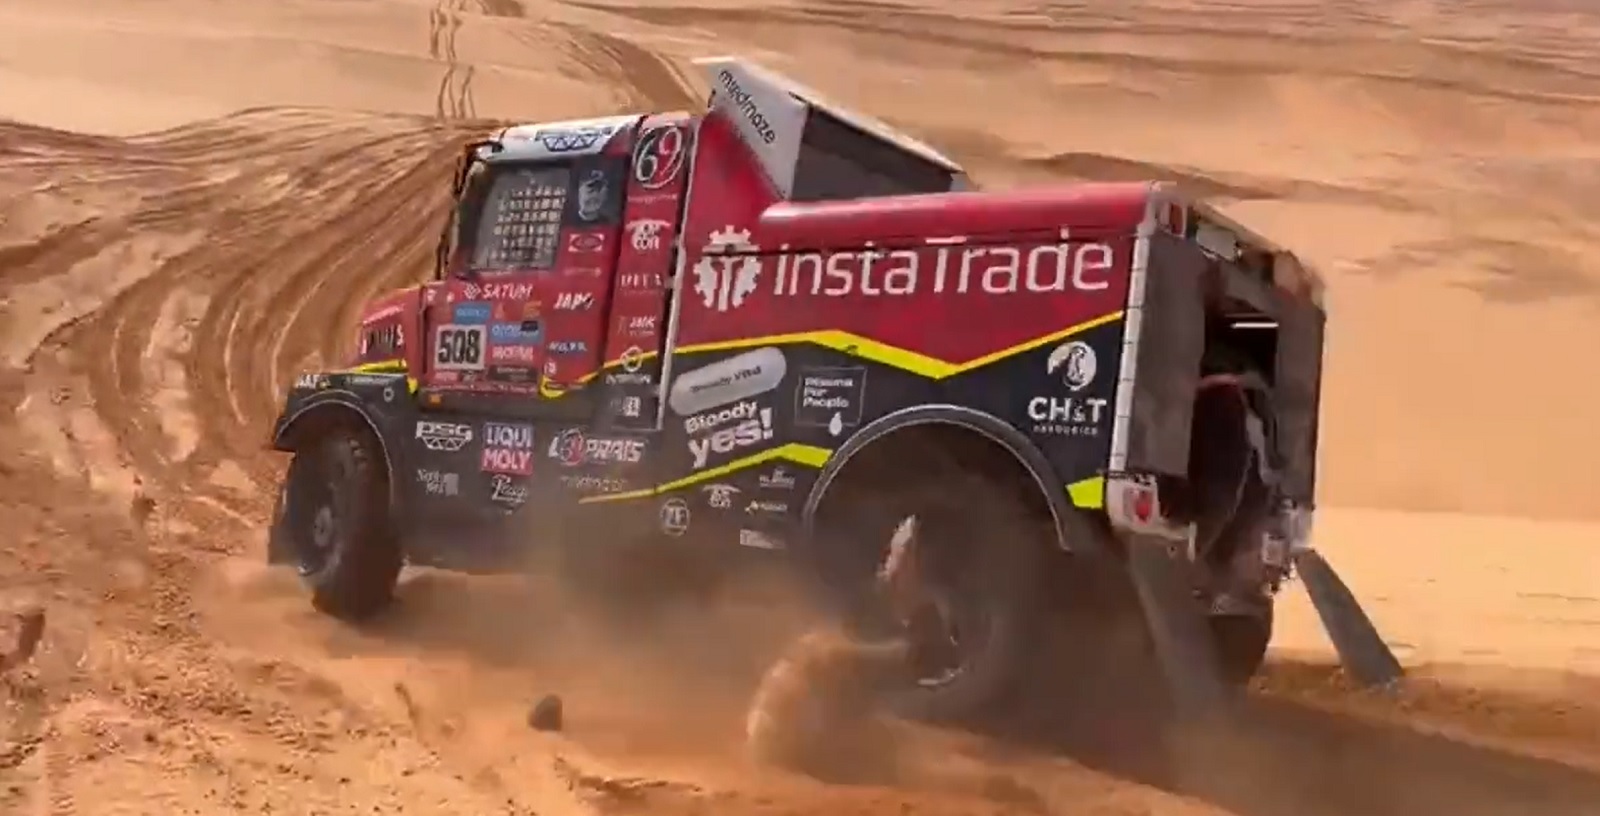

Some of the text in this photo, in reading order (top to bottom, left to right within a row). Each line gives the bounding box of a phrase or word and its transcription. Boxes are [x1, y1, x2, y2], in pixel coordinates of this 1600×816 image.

[437, 329, 482, 365] 508
[685, 401, 758, 435] Bloody
[1027, 396, 1108, 423] CH&T
[486, 424, 533, 448] LIQUI
[687, 407, 774, 470] yes!
[482, 448, 533, 471] MOLY
